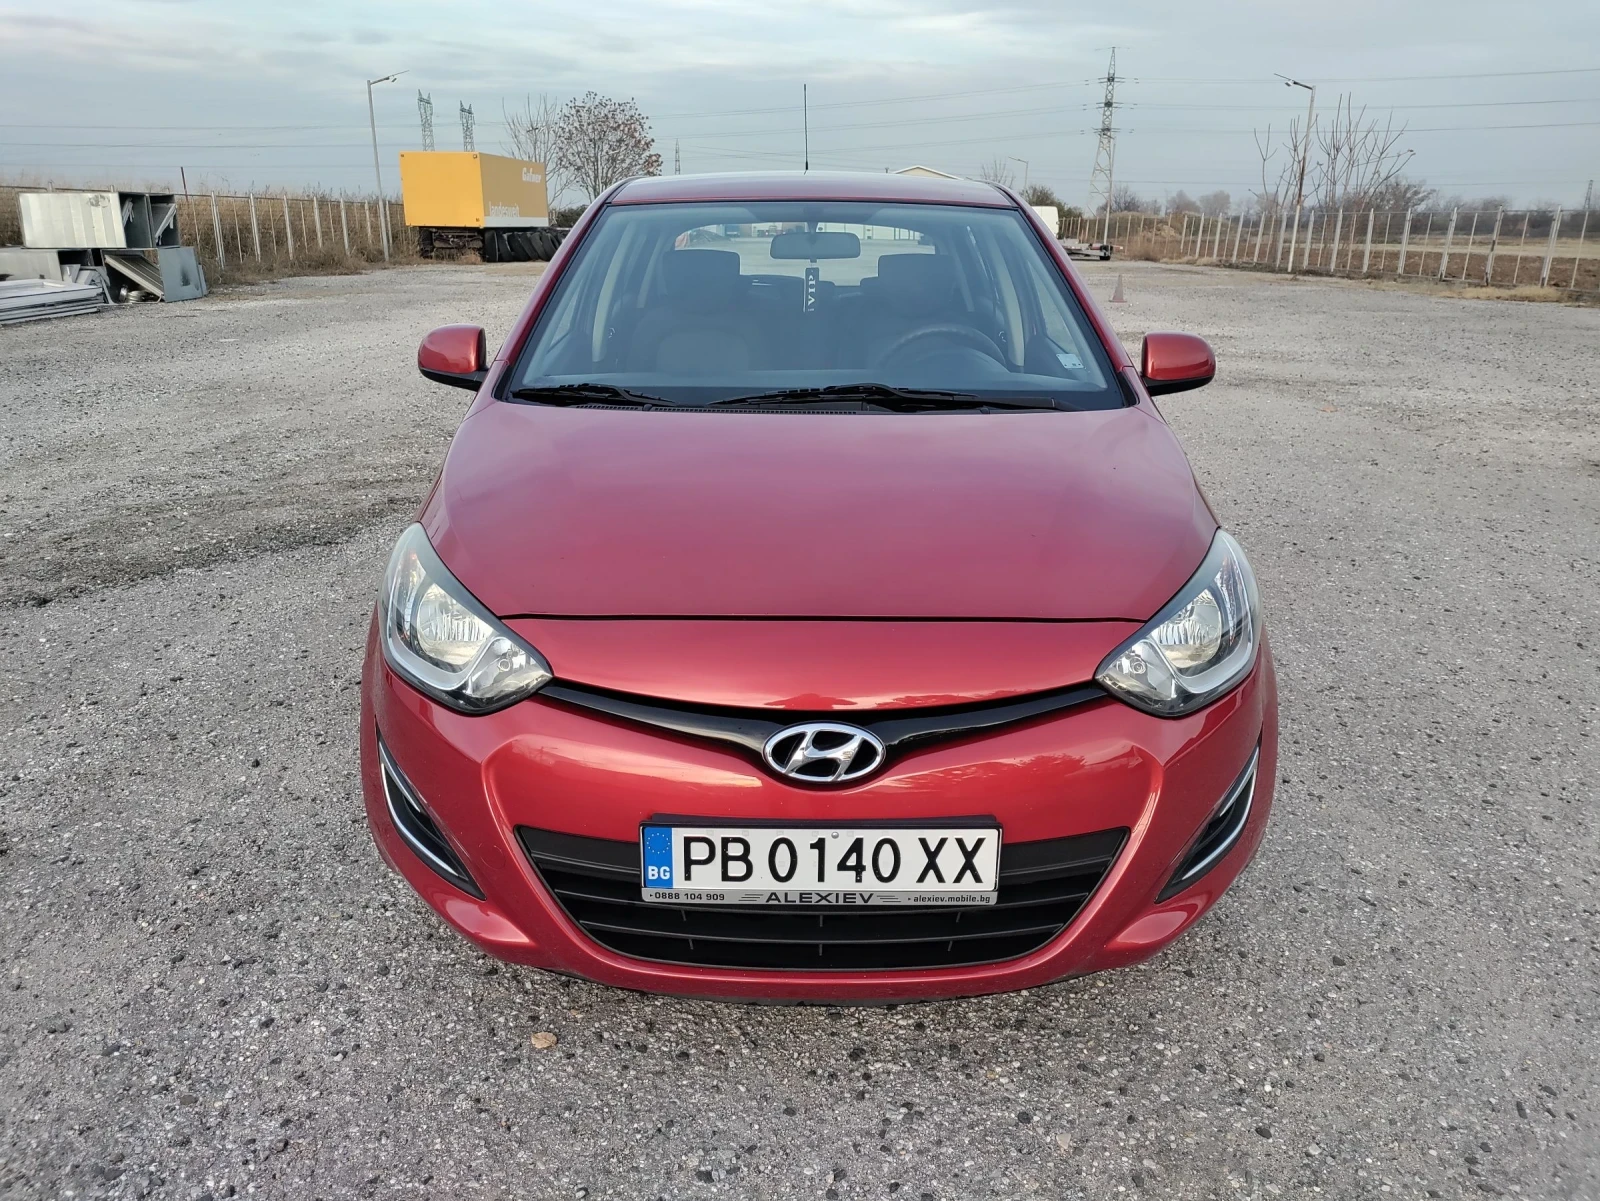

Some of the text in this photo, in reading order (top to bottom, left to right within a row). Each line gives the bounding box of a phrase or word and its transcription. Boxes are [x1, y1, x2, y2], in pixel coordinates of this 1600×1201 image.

[683, 836, 987, 884] PB 0140 XX
[648, 866, 671, 880] BG
[654, 891, 680, 900] 0888
[706, 893, 725, 901] 909
[765, 892, 874, 904] ALEXIEV
[913, 895, 991, 904] alexiev.mobile.bg
